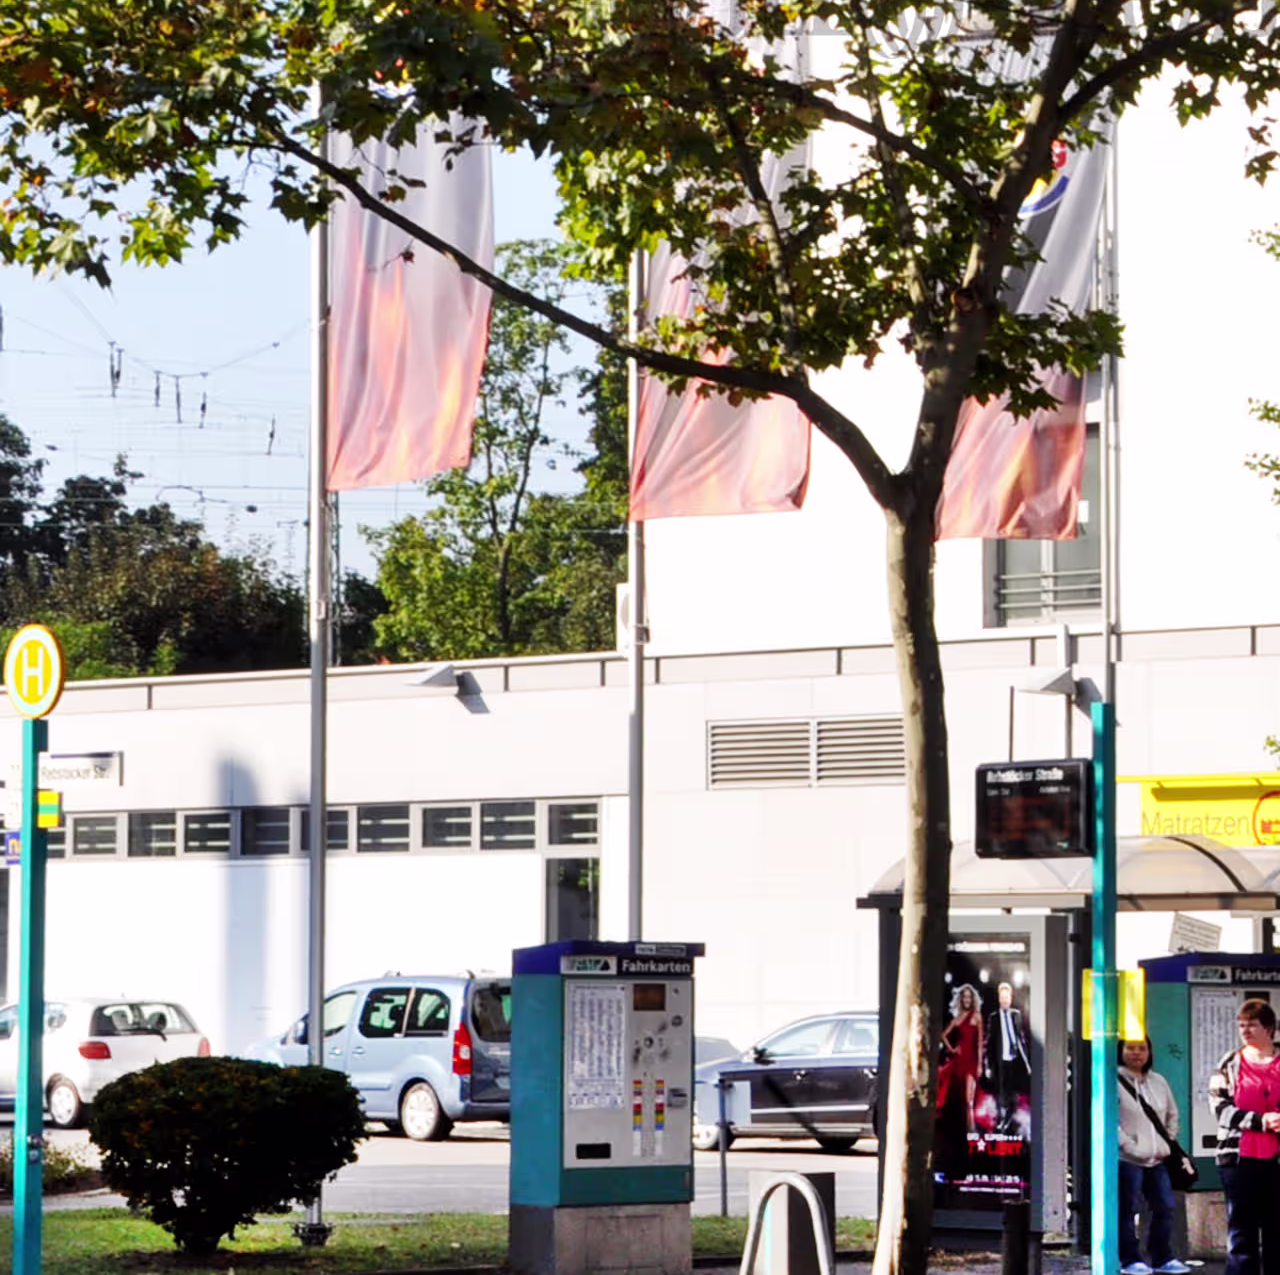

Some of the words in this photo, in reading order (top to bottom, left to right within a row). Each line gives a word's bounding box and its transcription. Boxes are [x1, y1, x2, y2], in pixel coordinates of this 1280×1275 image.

[22, 645, 44, 697] H
[1141, 811, 1250, 837] Matratzen
[622, 959, 691, 973] Fahrkarten
